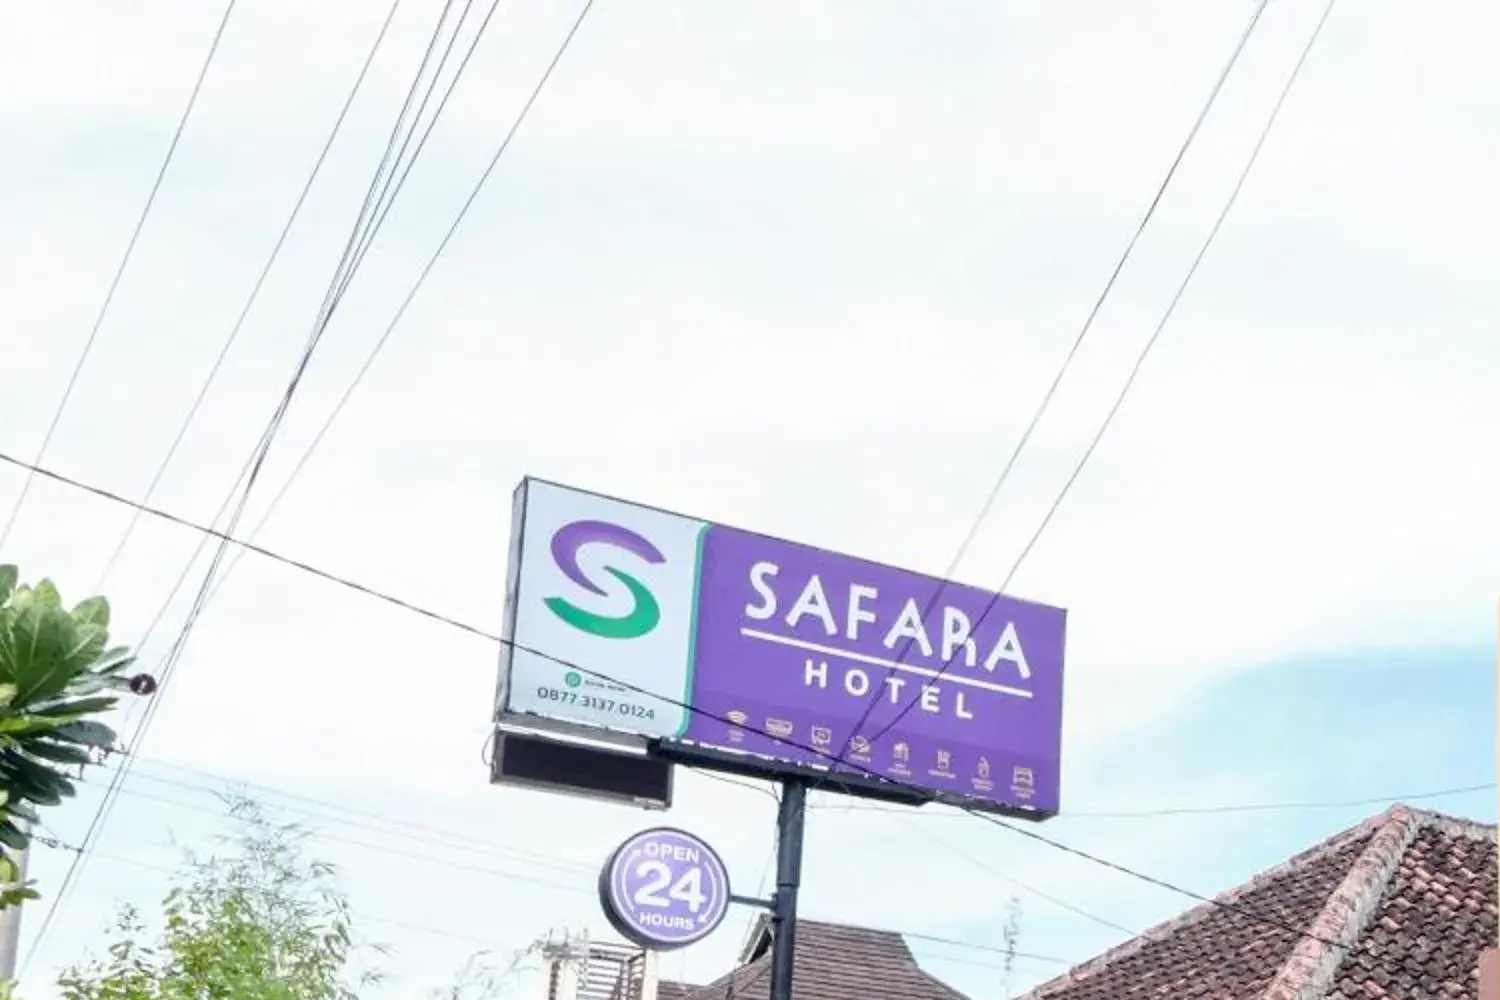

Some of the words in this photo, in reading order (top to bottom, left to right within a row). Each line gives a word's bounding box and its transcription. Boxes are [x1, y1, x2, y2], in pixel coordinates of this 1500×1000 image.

[743, 560, 1032, 681] SAFARA
[537, 686, 577, 705] 0877
[803, 657, 975, 721] HOTEL
[641, 841, 700, 863] OPEN
[634, 860, 707, 913] 24
[639, 911, 696, 931] HOURS
